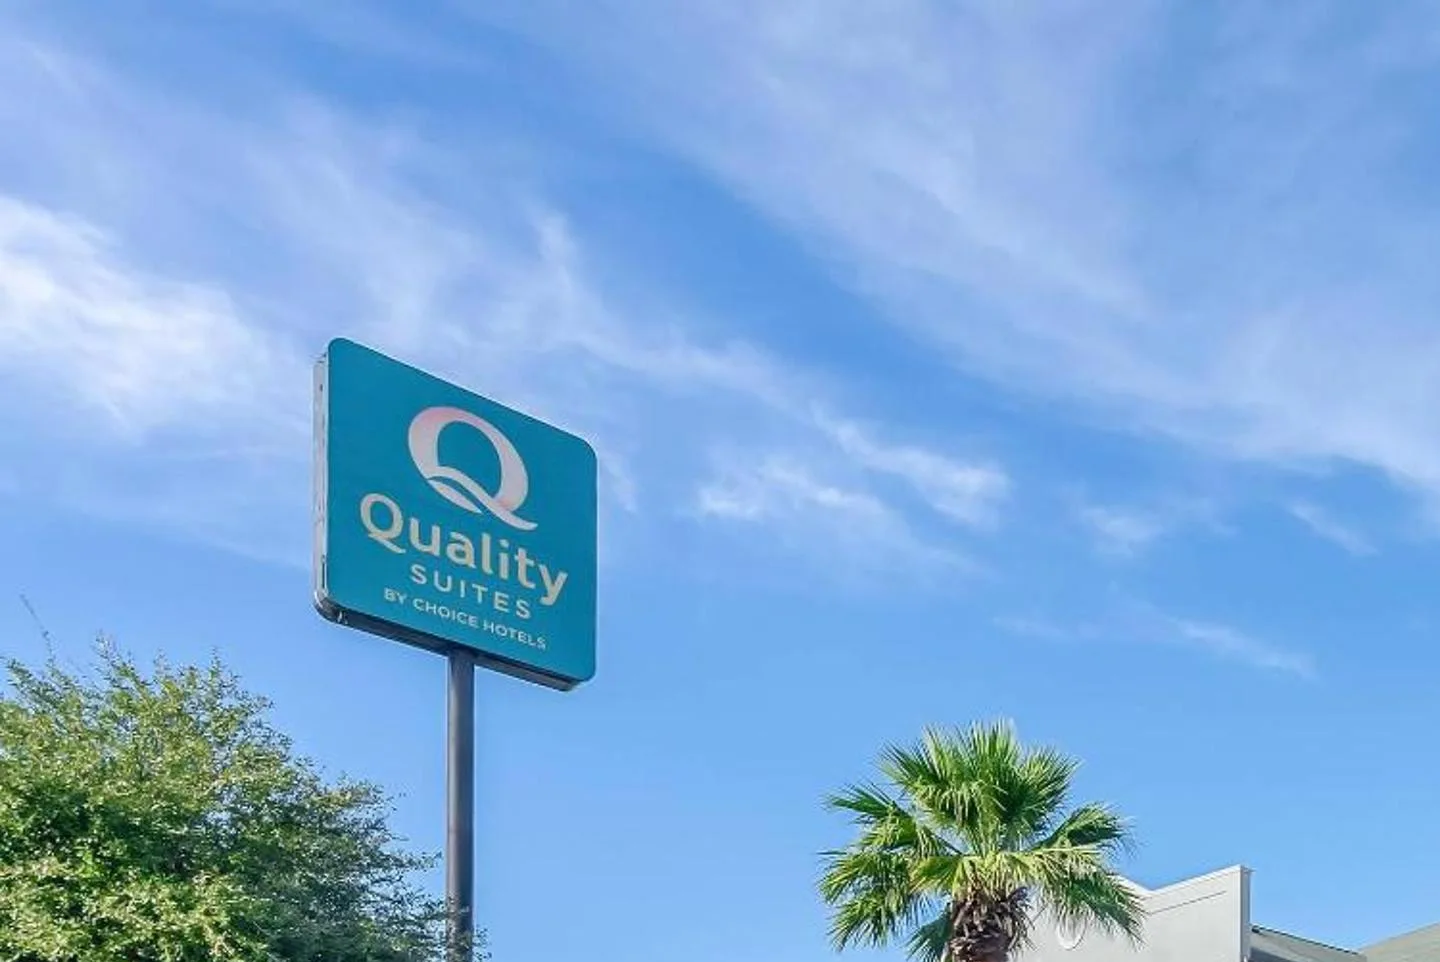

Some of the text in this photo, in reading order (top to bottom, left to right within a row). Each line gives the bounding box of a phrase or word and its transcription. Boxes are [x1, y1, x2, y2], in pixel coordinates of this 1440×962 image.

[407, 406, 538, 531] Q
[360, 493, 568, 606] Quality
[410, 564, 532, 620] SUITES
[384, 587, 547, 650] BY CHOICE HOTELS
